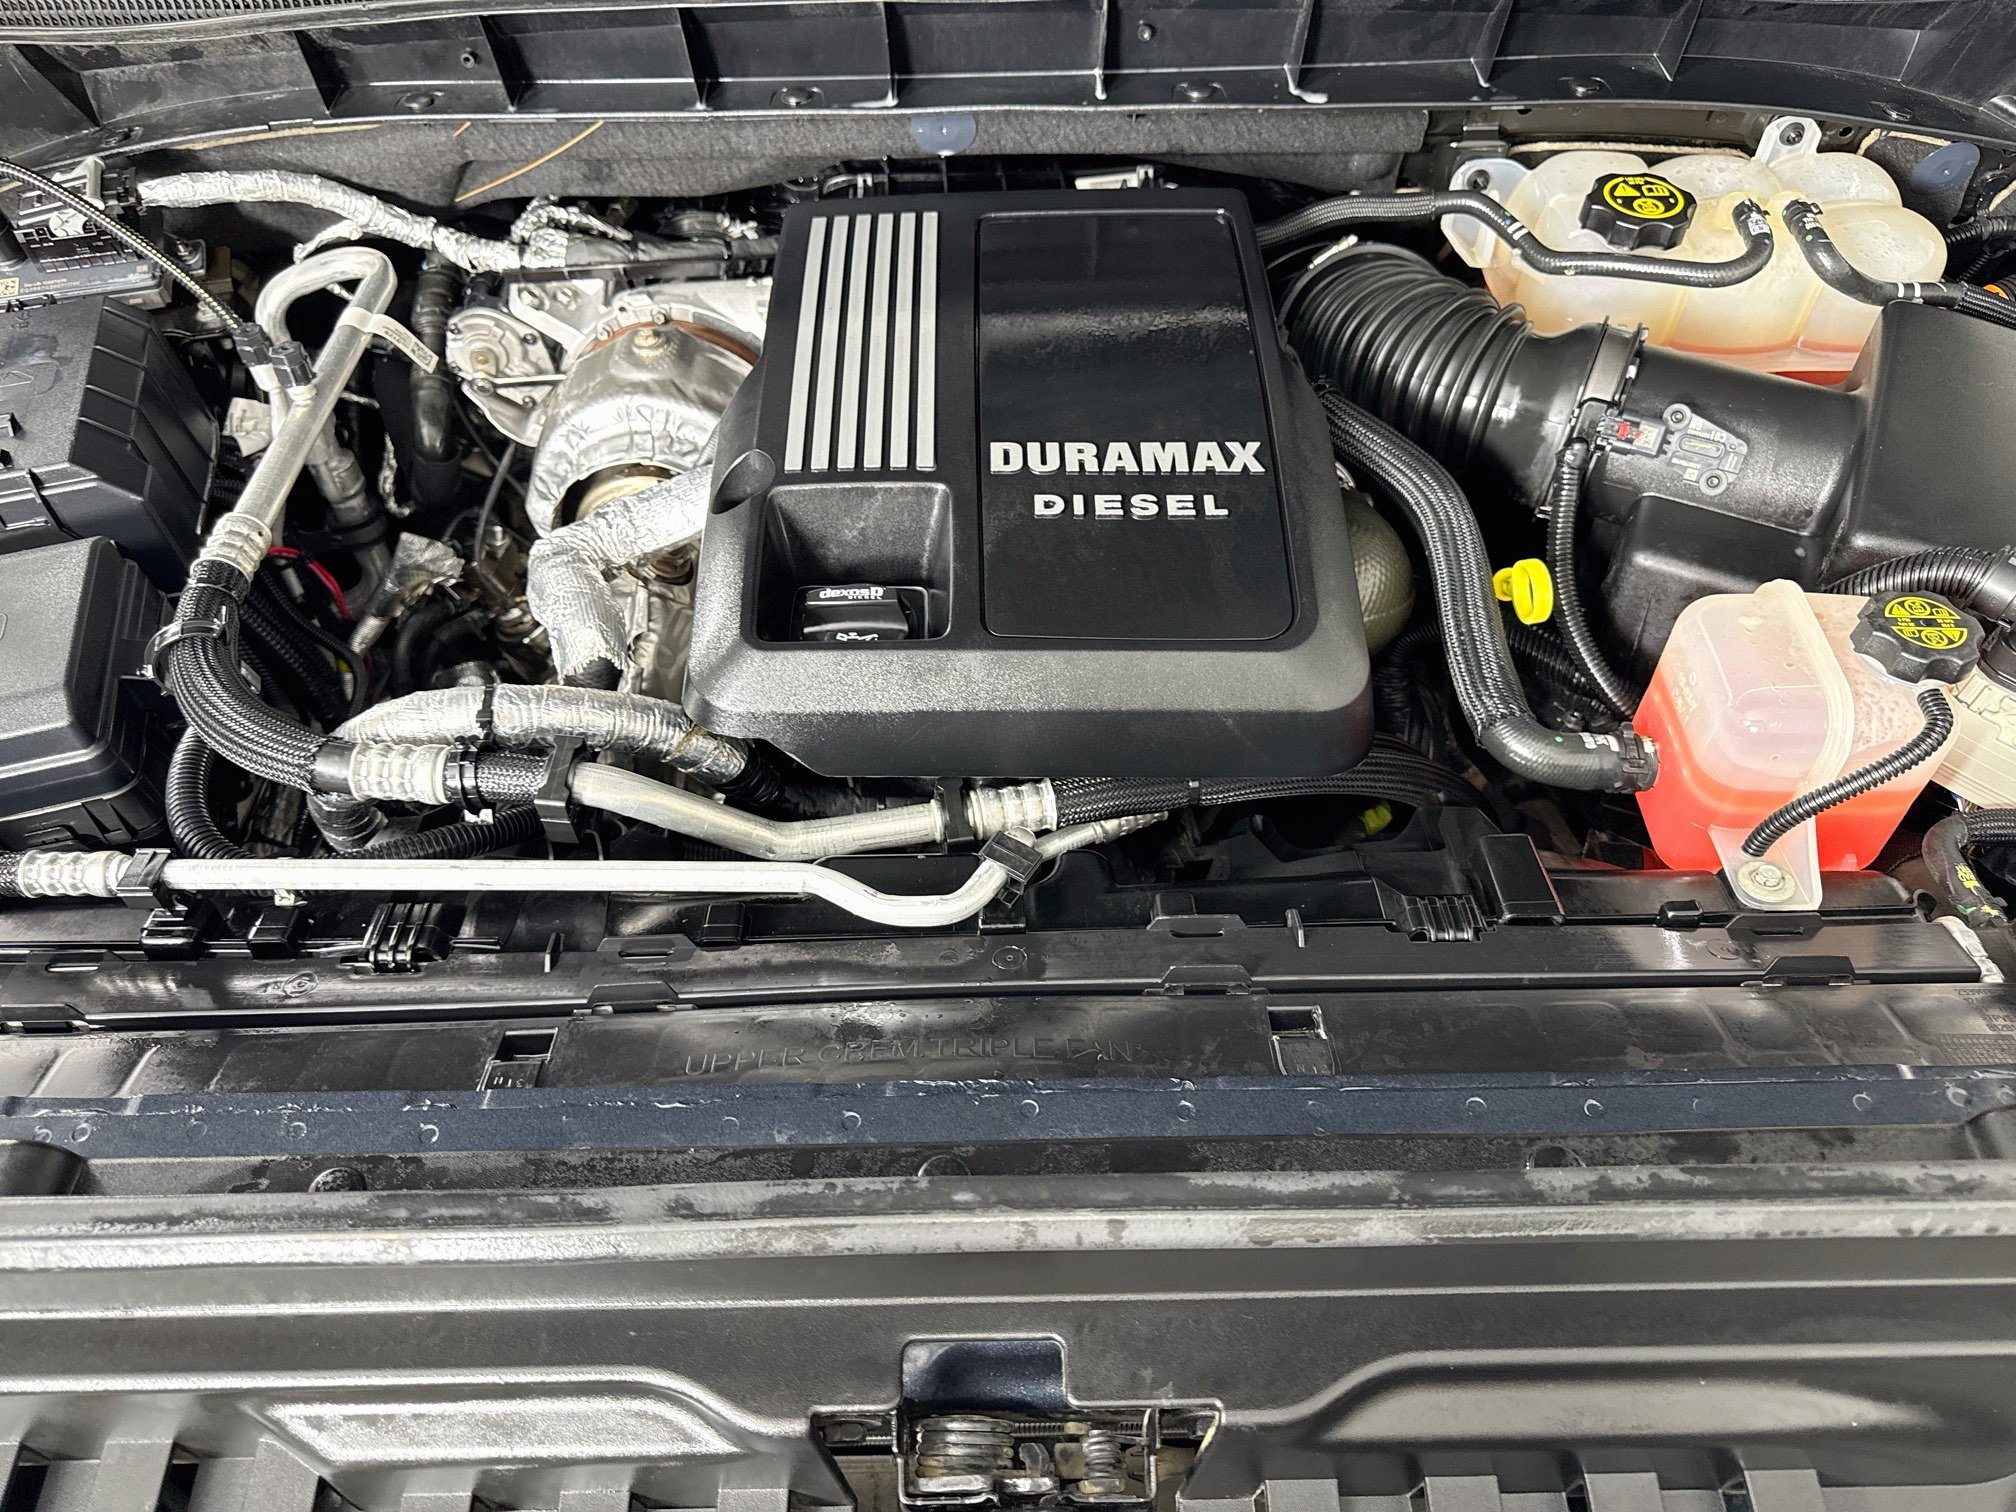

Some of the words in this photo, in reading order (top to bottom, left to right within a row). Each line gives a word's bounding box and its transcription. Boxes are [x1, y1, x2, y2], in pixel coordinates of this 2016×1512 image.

[990, 442, 1266, 475] DURAMAX
[1033, 494, 1230, 519] DIESEL
[685, 1048, 806, 1076] UPPER
[930, 1037, 1054, 1059] TRIPLE
